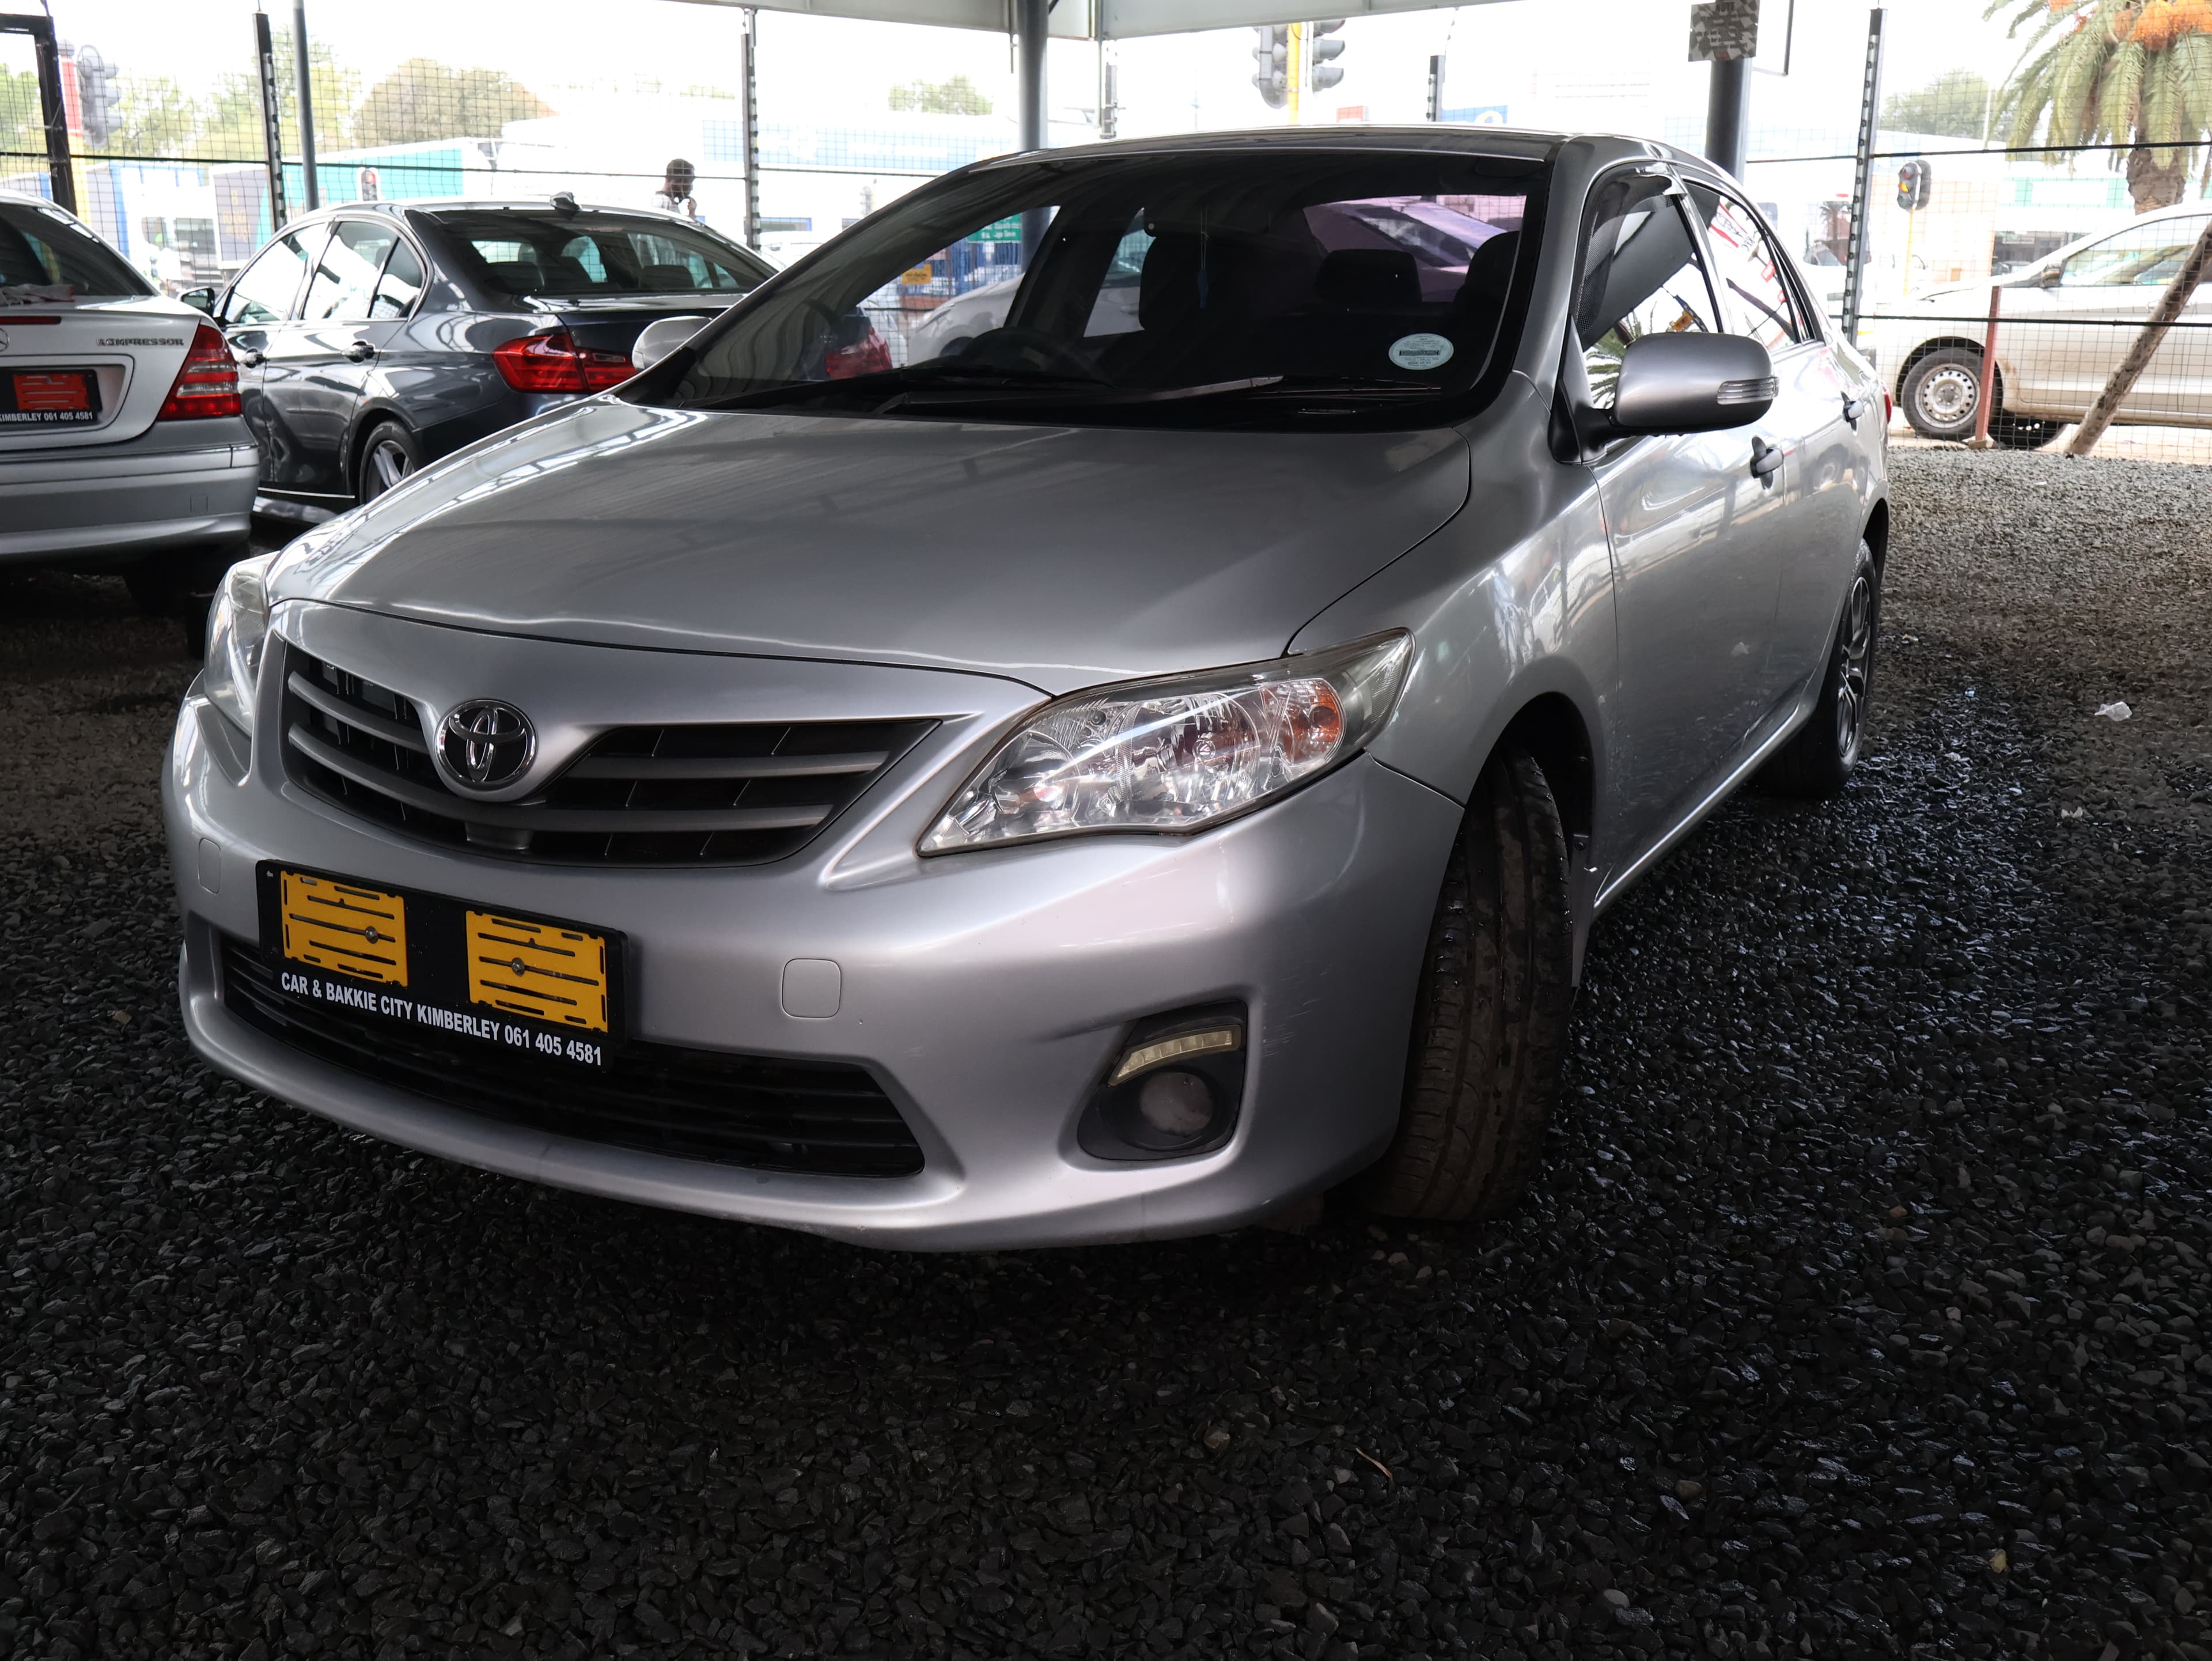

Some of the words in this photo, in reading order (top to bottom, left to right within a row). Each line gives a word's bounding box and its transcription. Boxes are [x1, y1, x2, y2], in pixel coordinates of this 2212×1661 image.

[44, 412, 57, 421] 061
[59, 411, 74, 421] 405
[75, 411, 93, 421] 4581
[281, 972, 308, 995] CAR
[312, 979, 322, 998] &
[326, 982, 377, 1011] BAKKIE
[381, 996, 413, 1020] CITY
[417, 1004, 500, 1041] KIMBERLEY
[505, 1025, 529, 1049] 061
[535, 1032, 562, 1056] 405
[566, 1040, 601, 1066] 4581
